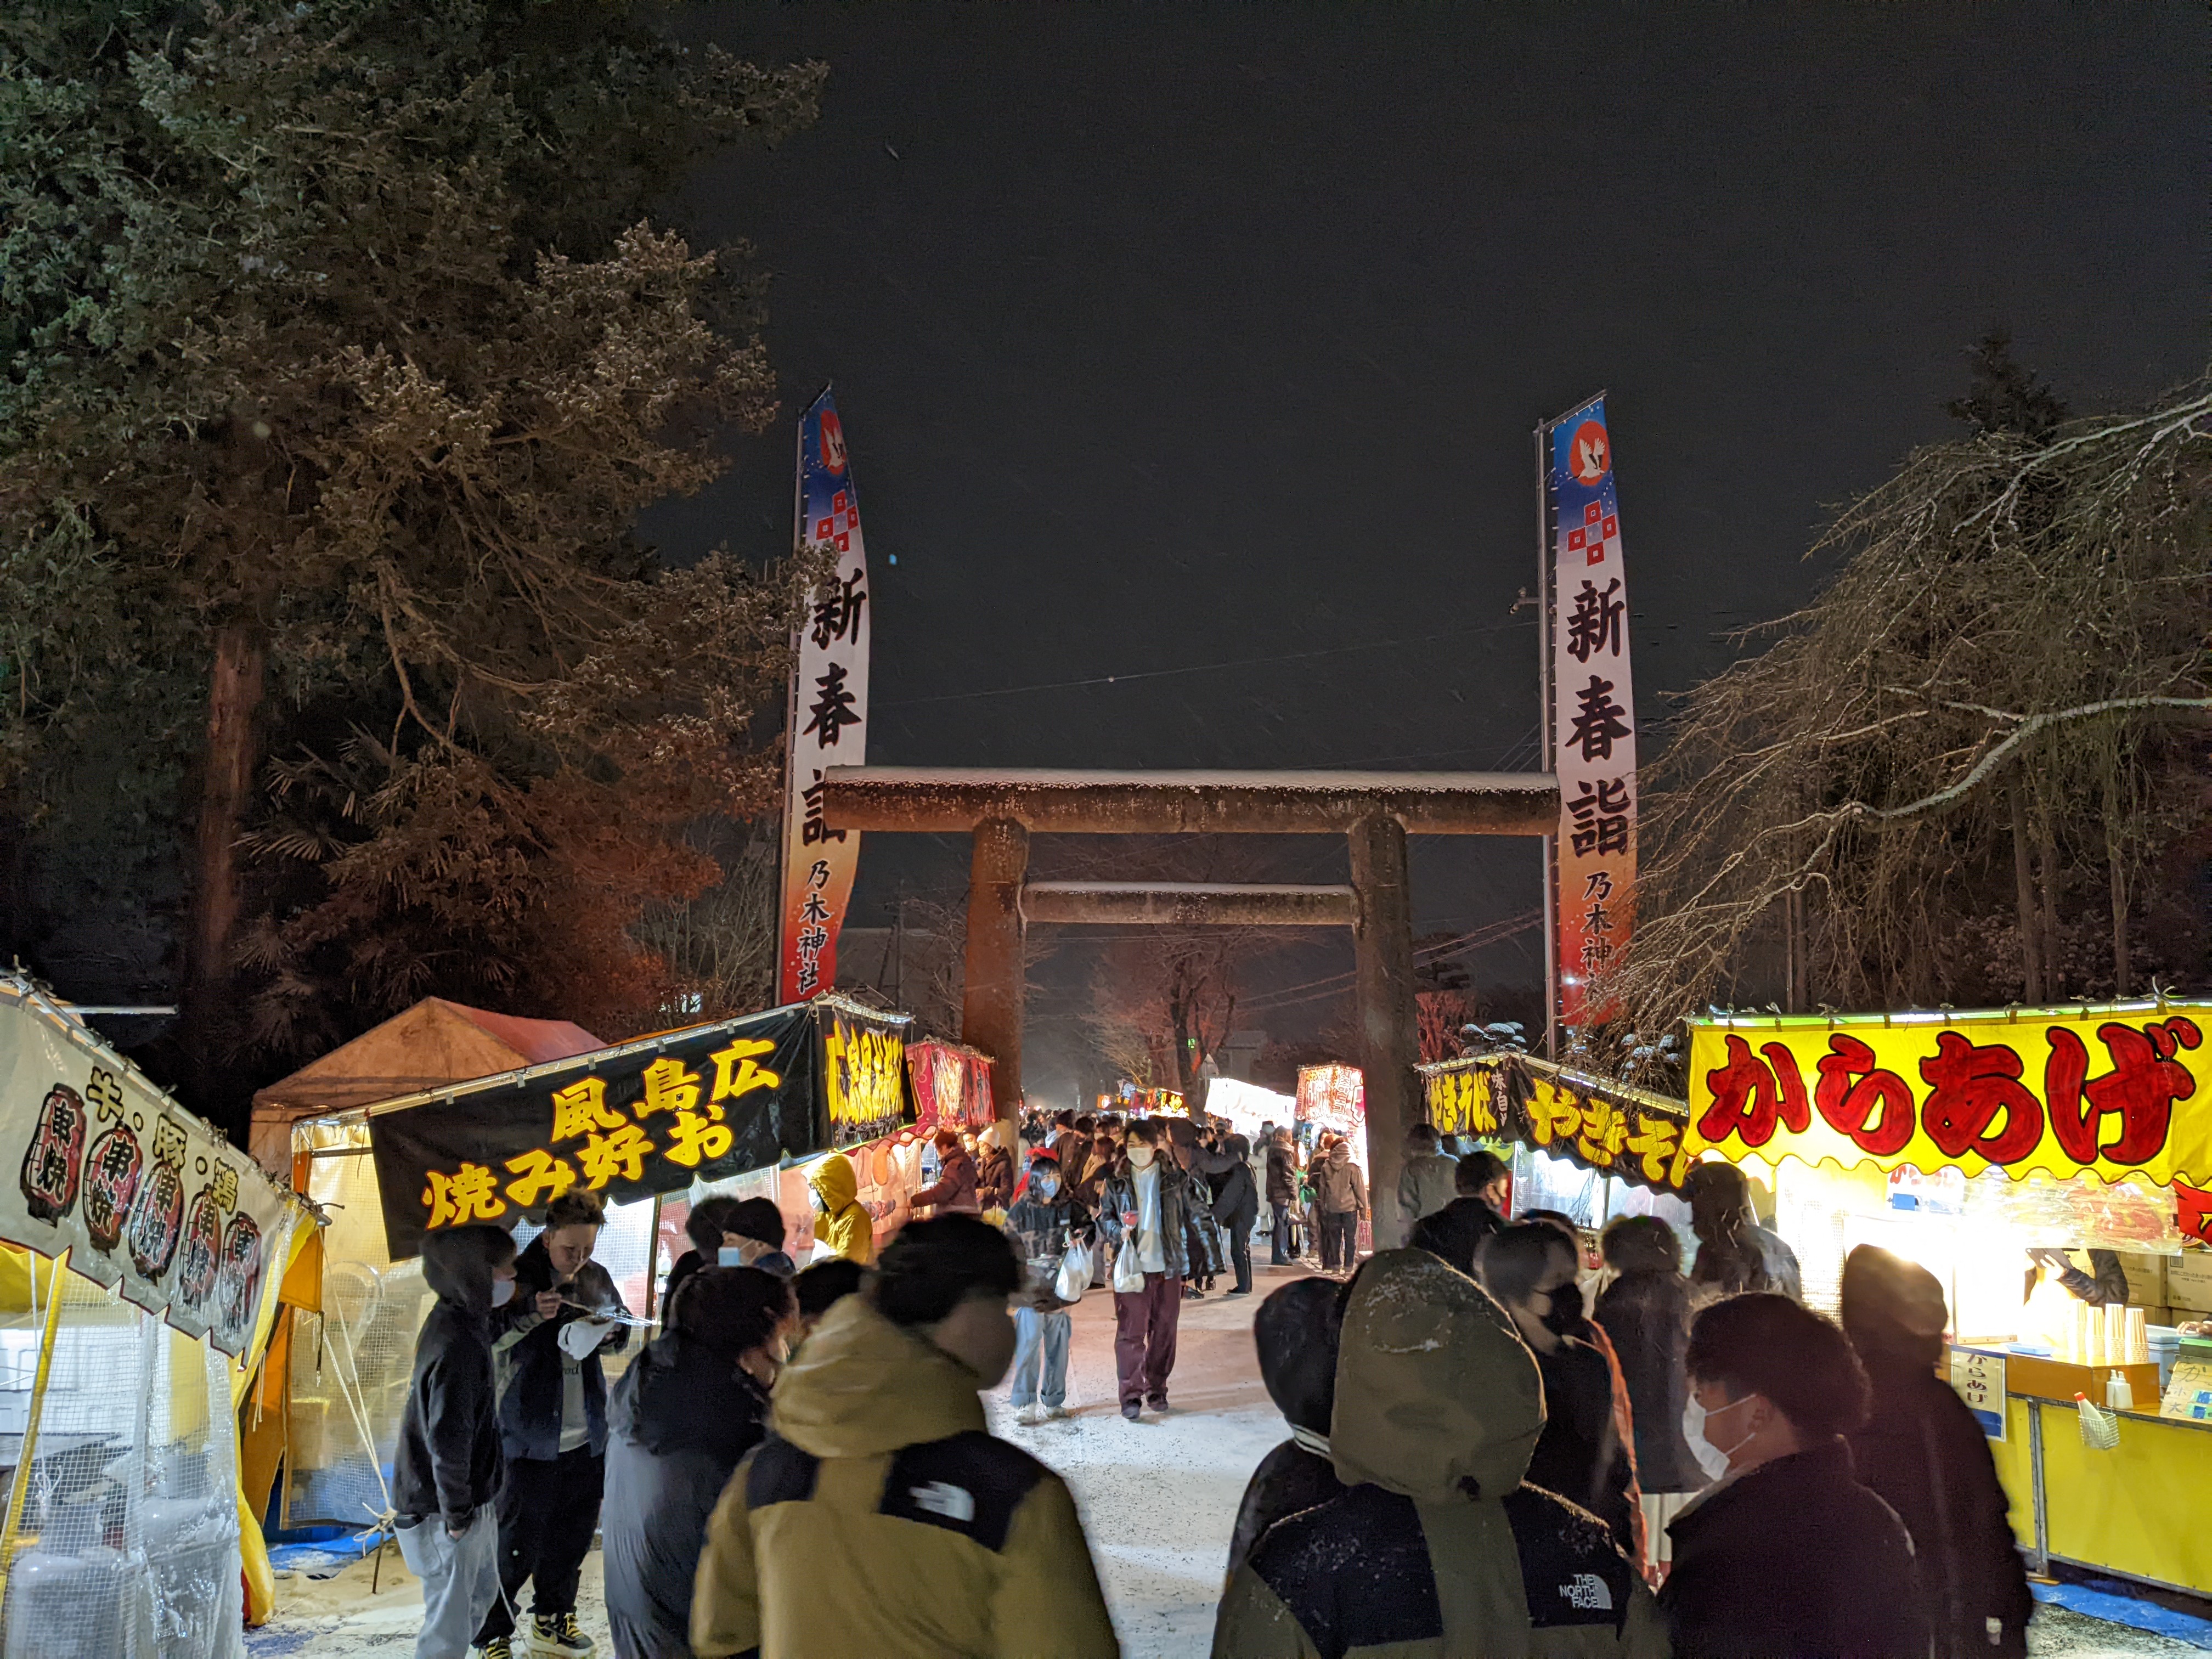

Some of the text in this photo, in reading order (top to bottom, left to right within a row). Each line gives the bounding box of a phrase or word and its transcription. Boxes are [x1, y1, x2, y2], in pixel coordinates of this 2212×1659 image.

[1565, 578, 1633, 857] 新春詣
[798, 859, 834, 994] 乃木神社
[1430, 1071, 1497, 1132] やきそば
[1697, 1015, 2202, 1166] からあげ
[1967, 1353, 1988, 1402] からあげ
[1559, 1584, 1595, 1597] NORTH
[1572, 1596, 1598, 1609] FACE
[1573, 1573, 1595, 1585] THE
